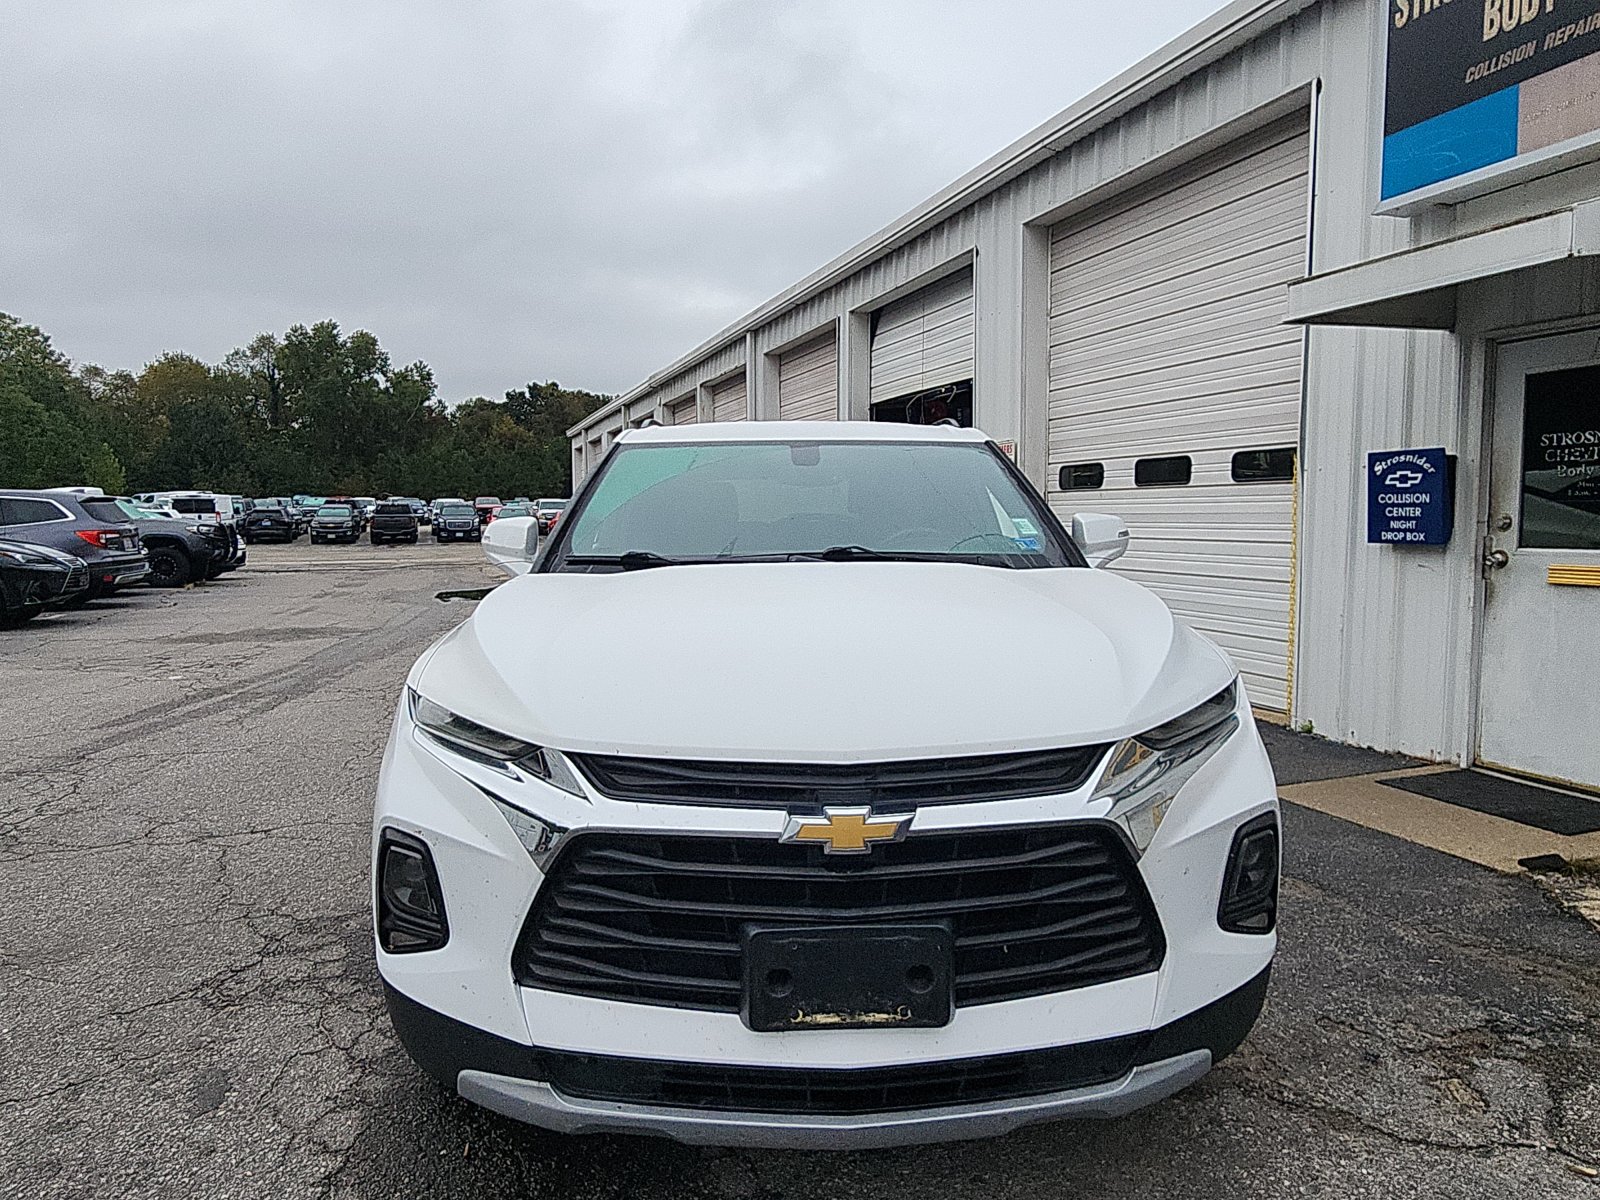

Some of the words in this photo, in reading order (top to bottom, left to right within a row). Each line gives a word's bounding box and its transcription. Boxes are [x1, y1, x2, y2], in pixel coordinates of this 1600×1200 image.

[1483, 0, 1554, 41] BO
[1465, 40, 1537, 83] COLLISION
[1374, 455, 1436, 475] Strosnider
[1557, 464, 1595, 479] Body
[1378, 493, 1430, 503] COLLISION
[1385, 507, 1422, 517] CENTER
[1390, 520, 1416, 529] NIGHT
[1381, 532, 1404, 541] DROP
[1406, 532, 1425, 541] BOX
